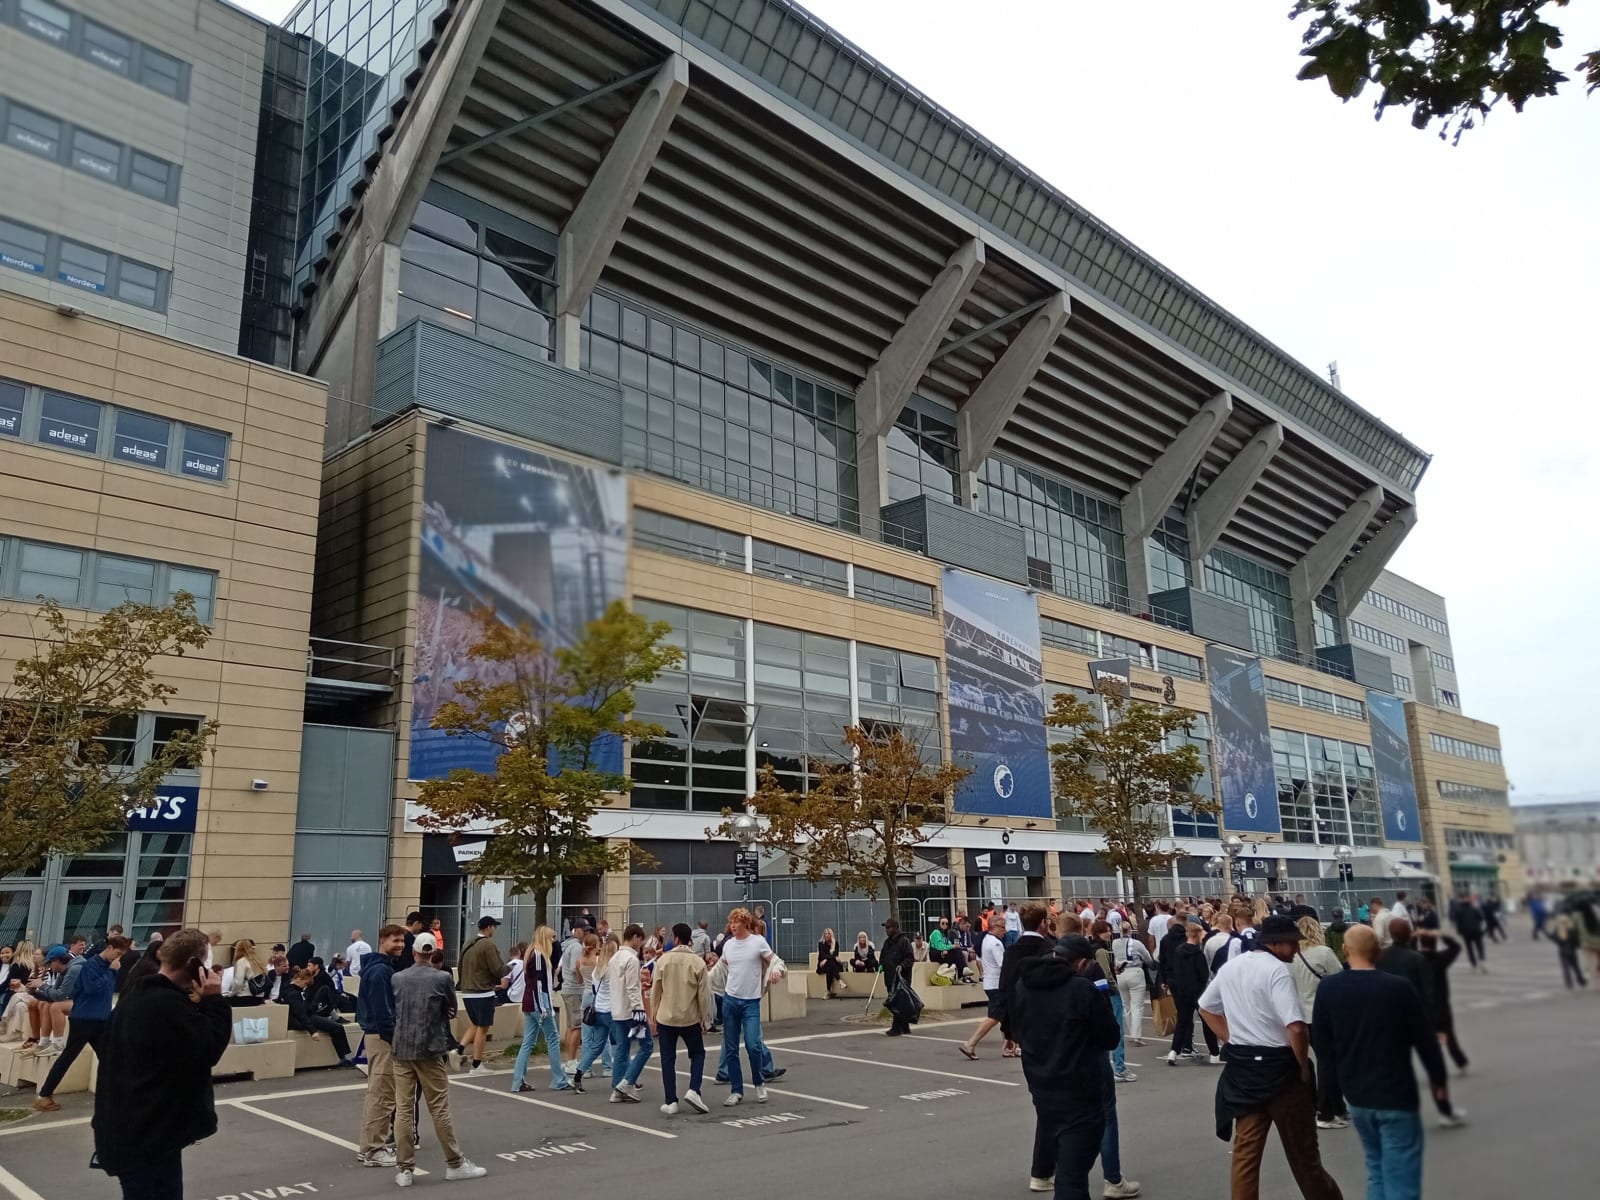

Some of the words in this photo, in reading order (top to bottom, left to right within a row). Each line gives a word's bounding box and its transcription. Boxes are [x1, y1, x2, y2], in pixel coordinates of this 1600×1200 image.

[2, 255, 35, 270] Nordea
[67, 275, 97, 290] Nordea
[49, 428, 87, 444] adeas
[122, 444, 158, 460] adeas
[185, 459, 219, 473] adeas
[737, 853, 744, 863] P
[722, 1112, 806, 1129] PRIVAT
[496, 1142, 598, 1162] PRIVAT
[203, 1182, 320, 1200] RIVAT
